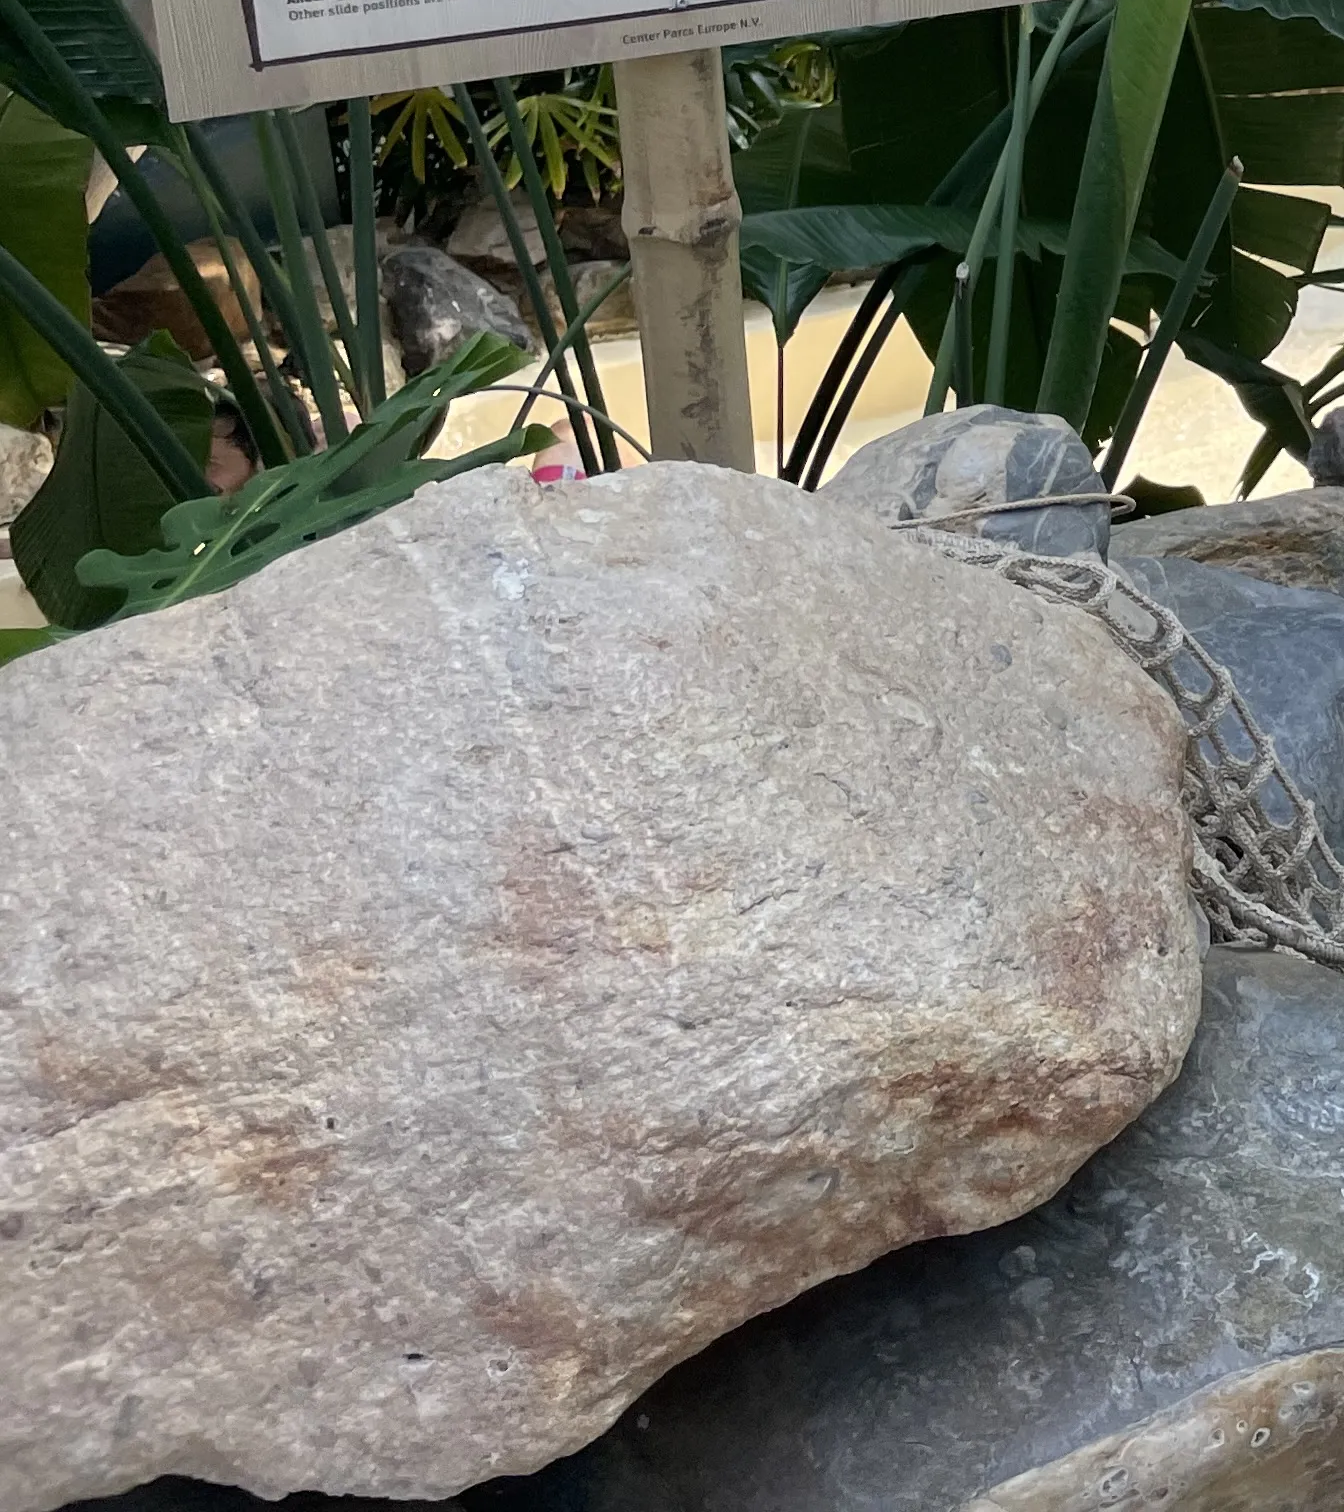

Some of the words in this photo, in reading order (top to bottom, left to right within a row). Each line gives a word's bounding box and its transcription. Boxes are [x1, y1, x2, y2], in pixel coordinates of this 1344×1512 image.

[622, 31, 661, 45] Center
[663, 27, 694, 39] Parcs
[697, 21, 737, 35] Europe
